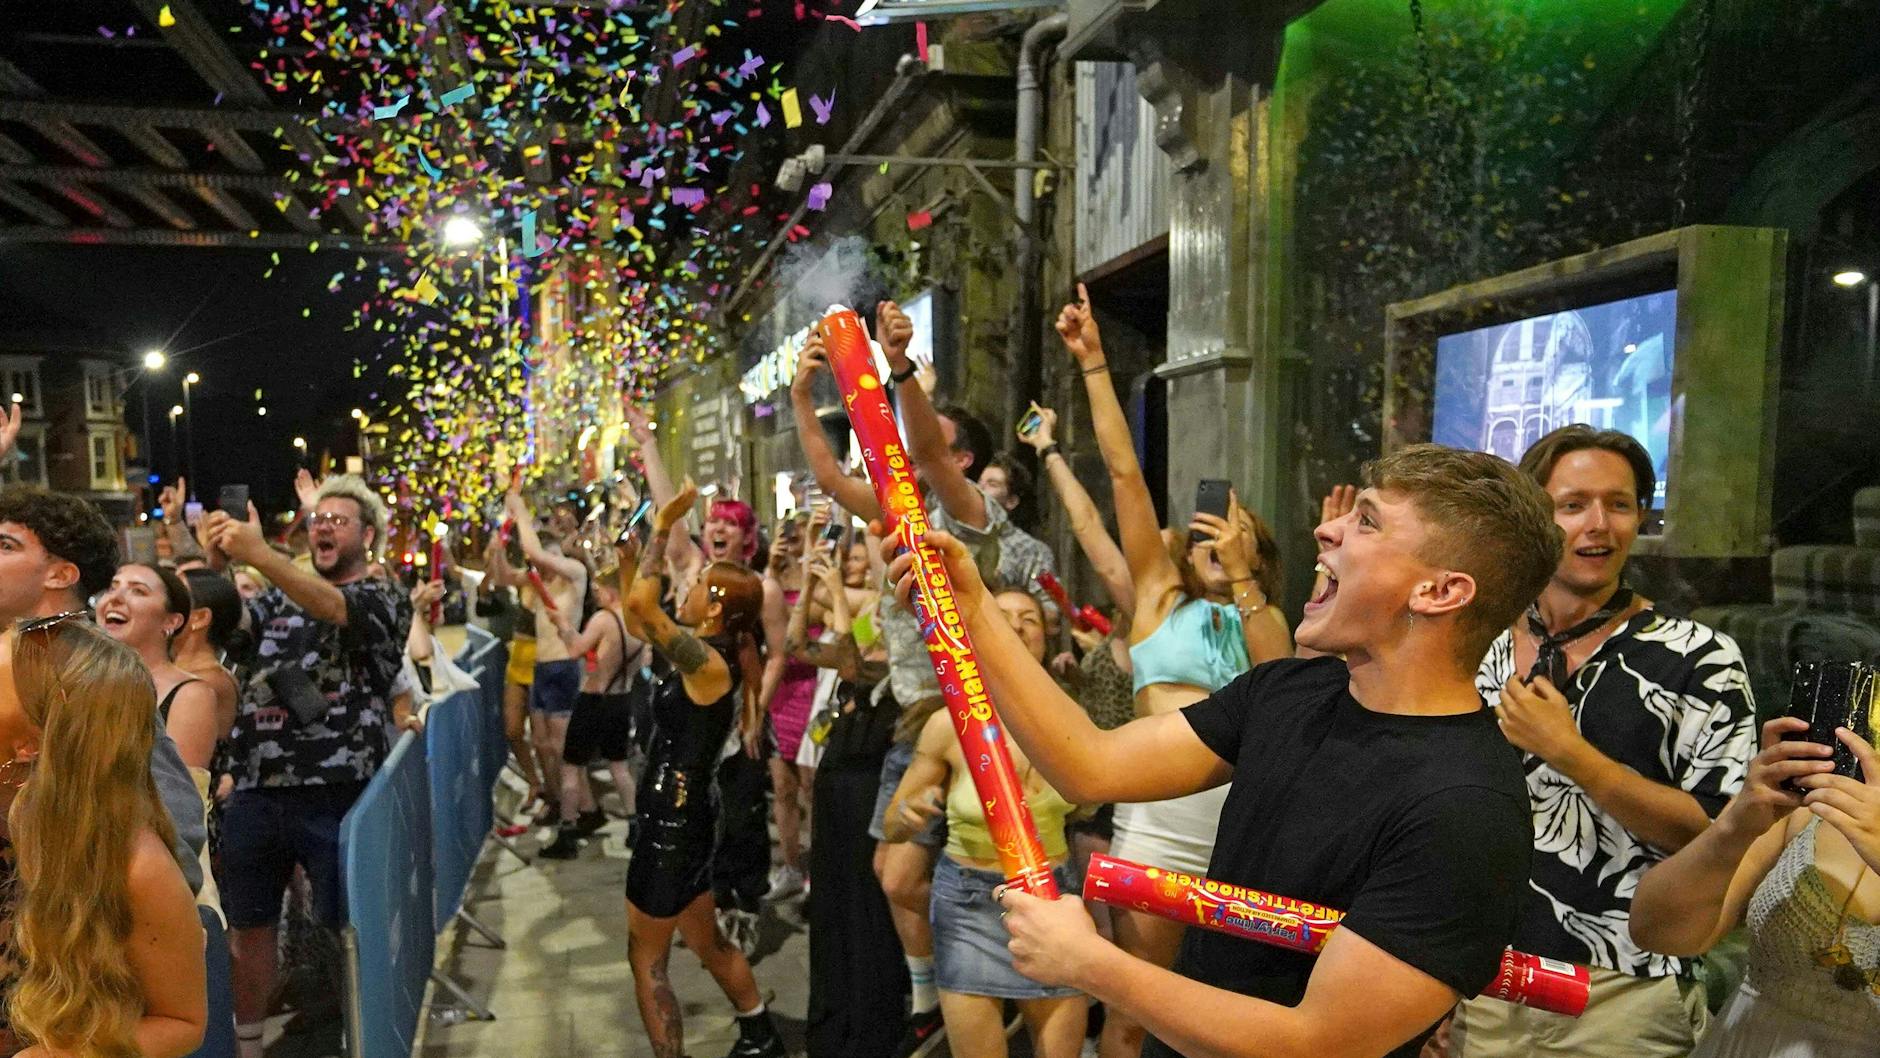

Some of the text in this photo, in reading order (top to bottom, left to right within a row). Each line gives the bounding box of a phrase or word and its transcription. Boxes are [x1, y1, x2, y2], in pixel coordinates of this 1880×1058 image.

[1164, 889, 1177, 899] NO
[1232, 905, 1296, 925] COMPRESSED AIR ACTION
[1266, 894, 1347, 922] NFeTTI
[1226, 915, 1297, 942] Party Time
